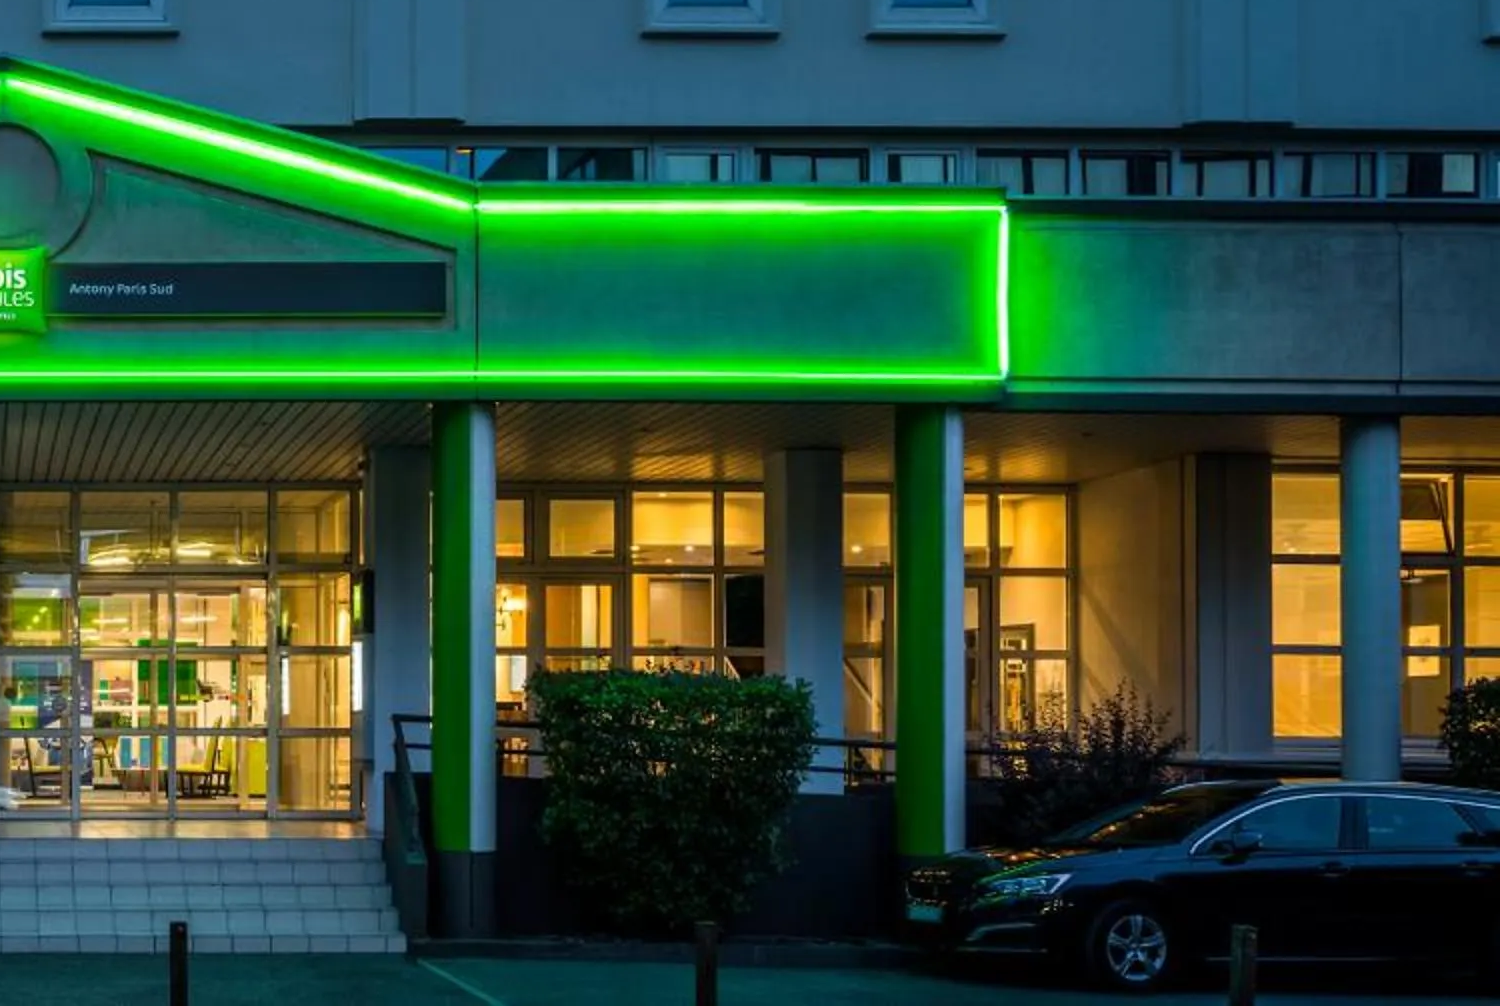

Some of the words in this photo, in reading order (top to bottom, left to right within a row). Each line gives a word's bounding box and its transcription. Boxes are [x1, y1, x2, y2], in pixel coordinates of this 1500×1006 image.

[69, 283, 115, 298] Antony
[117, 283, 147, 295] Paris
[149, 283, 173, 295] Sud
